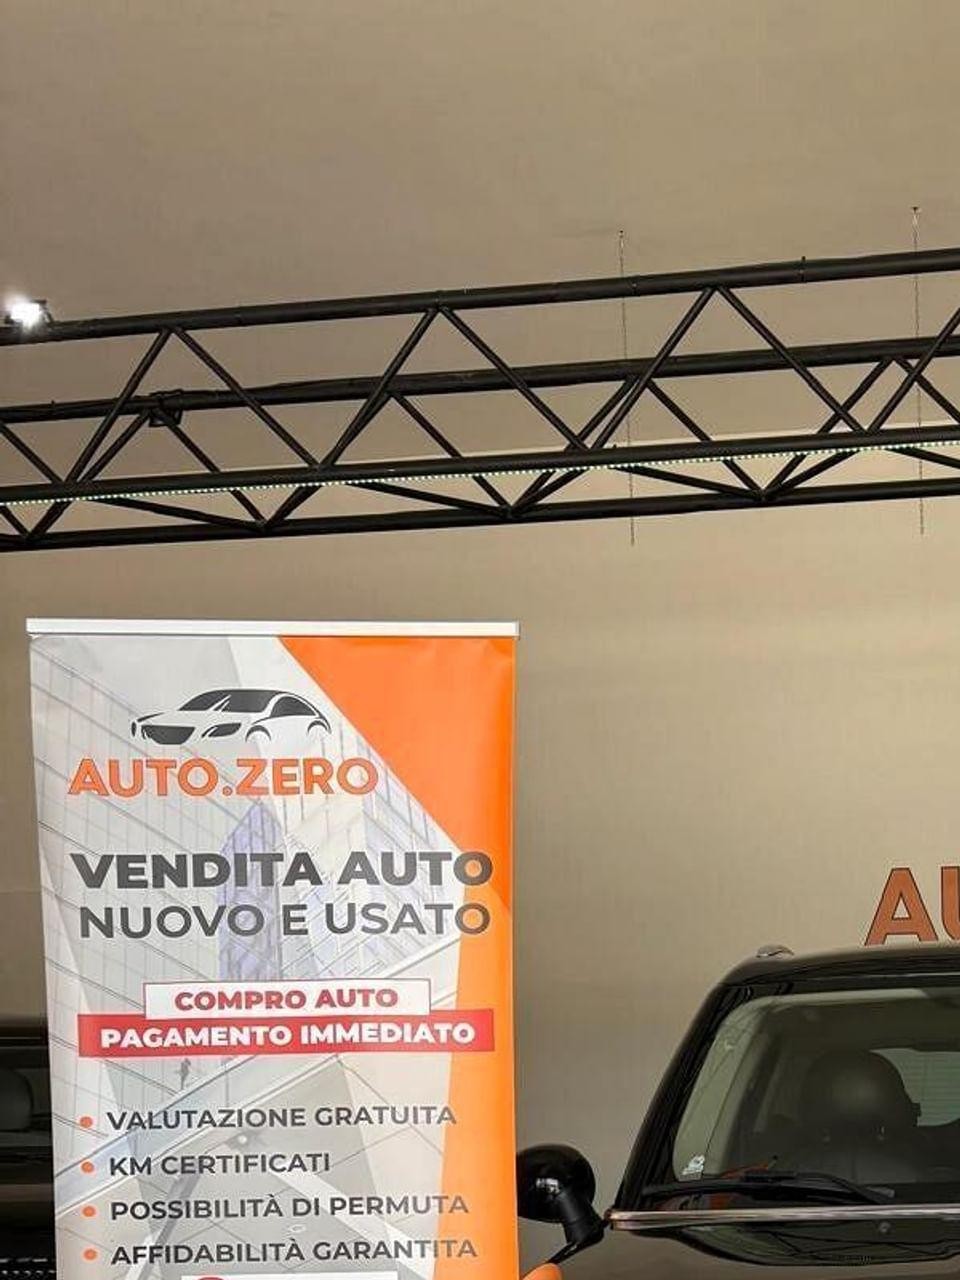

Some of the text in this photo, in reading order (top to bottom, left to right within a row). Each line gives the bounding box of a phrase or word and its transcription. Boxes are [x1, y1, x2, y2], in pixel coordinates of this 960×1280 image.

[68, 757, 378, 798] AUTO.ZERO
[70, 851, 493, 889] VENDITA AUTO
[80, 902, 490, 938] NUOVO E USATO
[174, 988, 398, 1011] COMPRO AUTO
[101, 1022, 475, 1048] PAGAMENTO IMMEDIATO
[107, 1106, 457, 1131] VALUTAZIONE GRATUITA
[109, 1153, 330, 1176] KM CERTIFICATI
[111, 1194, 469, 1220] POSSIBILITÀ DI PERMUTA
[111, 1239, 477, 1265] AFFIDABILITÀ GARANTITA
